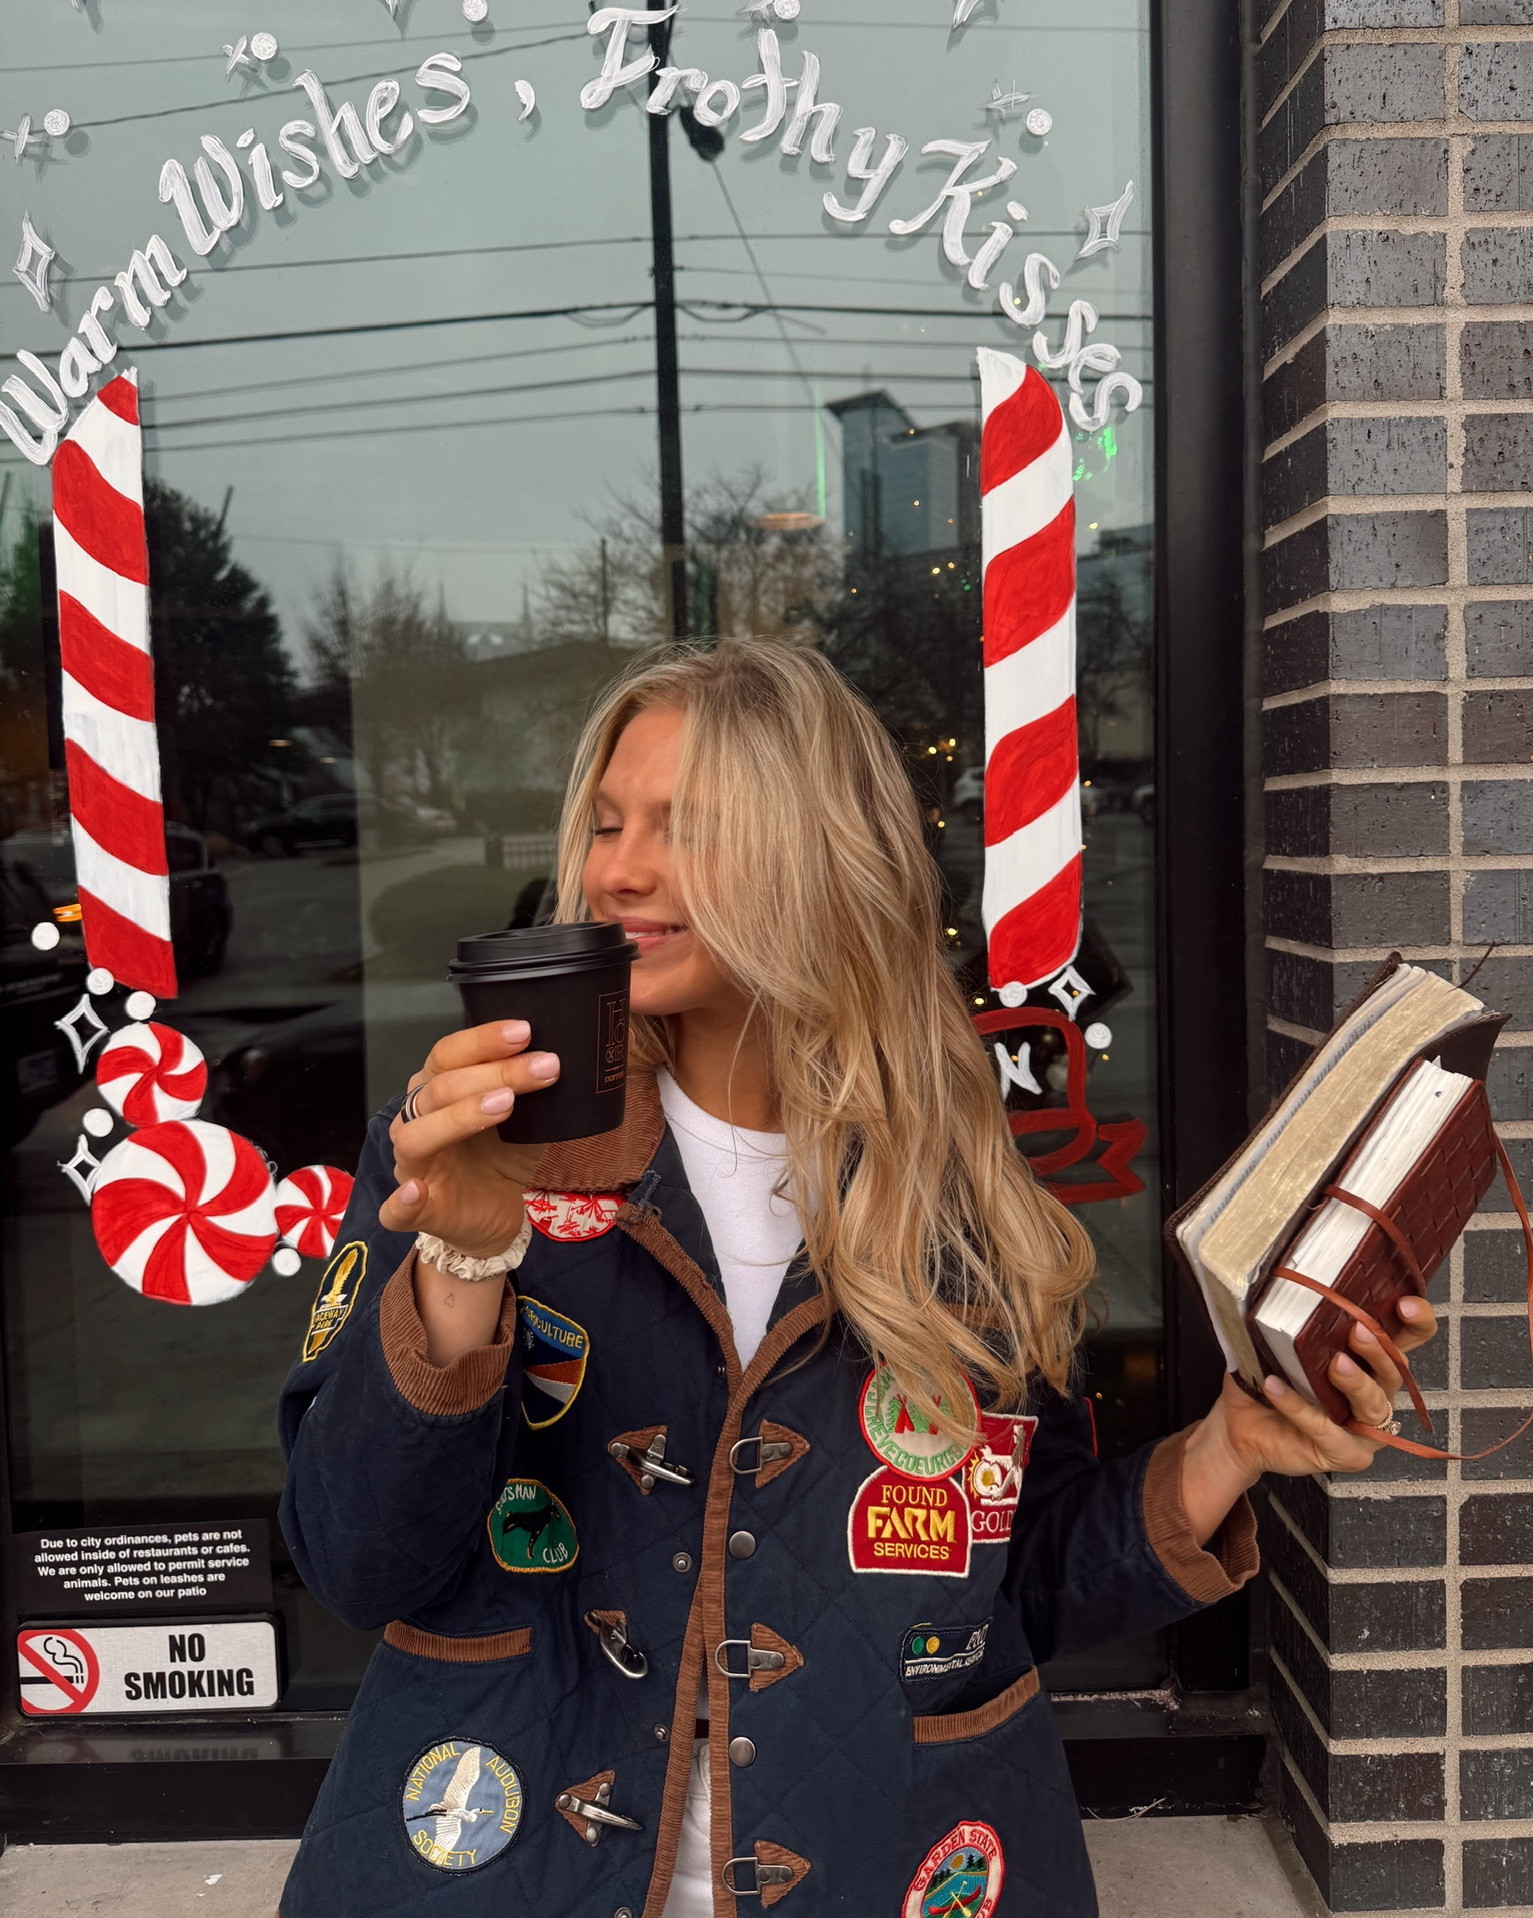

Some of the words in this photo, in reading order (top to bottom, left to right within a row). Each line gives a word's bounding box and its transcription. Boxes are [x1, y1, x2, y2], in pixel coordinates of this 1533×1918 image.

[0, 234, 187, 466] Warm
[580, 5, 909, 221] Frothy
[888, 139, 1142, 430] Kisses
[881, 1485, 948, 1506] FOUND
[867, 1505, 956, 1542] FARM
[41, 1538, 63, 1549] Due
[67, 1537, 77, 1547] to
[81, 1536, 101, 1548] city
[105, 1534, 171, 1546] ordinances,
[174, 1532, 199, 1544] pets
[202, 1531, 220, 1540] are
[223, 1530, 242, 1539] not
[34, 1552, 78, 1562] allowed
[81, 1550, 116, 1560] inside
[119, 1549, 130, 1558] of
[133, 1545, 198, 1558] restaurants
[201, 1545, 213, 1554] or
[216, 1542, 250, 1553] cafes.
[543, 1542, 569, 1563] CLUB
[873, 1543, 950, 1560] SERVICES
[38, 1566, 55, 1576] We
[59, 1567, 76, 1575] are
[79, 1564, 104, 1576] only
[107, 1562, 150, 1573] allowed
[154, 1561, 165, 1570] to
[169, 1558, 205, 1572] permit
[208, 1557, 249, 1568] service
[64, 1577, 111, 1588] animals.
[114, 1576, 139, 1586] Pets
[143, 1576, 157, 1584] on
[160, 1573, 204, 1583] leashes
[207, 1572, 225, 1581] are
[84, 1589, 135, 1601] welcome
[138, 1590, 152, 1598] on
[156, 1589, 175, 1597] our
[178, 1587, 206, 1597] patio
[169, 1633, 205, 1662] NO
[125, 1668, 254, 1700] SMOKING
[406, 1743, 460, 1801] NATIONAL
[486, 1755, 521, 1835] AUDUBON
[413, 1830, 477, 1866] SOCIETY
[914, 1829, 966, 1891] GARDEN
[970, 1829, 998, 1862] STATE
